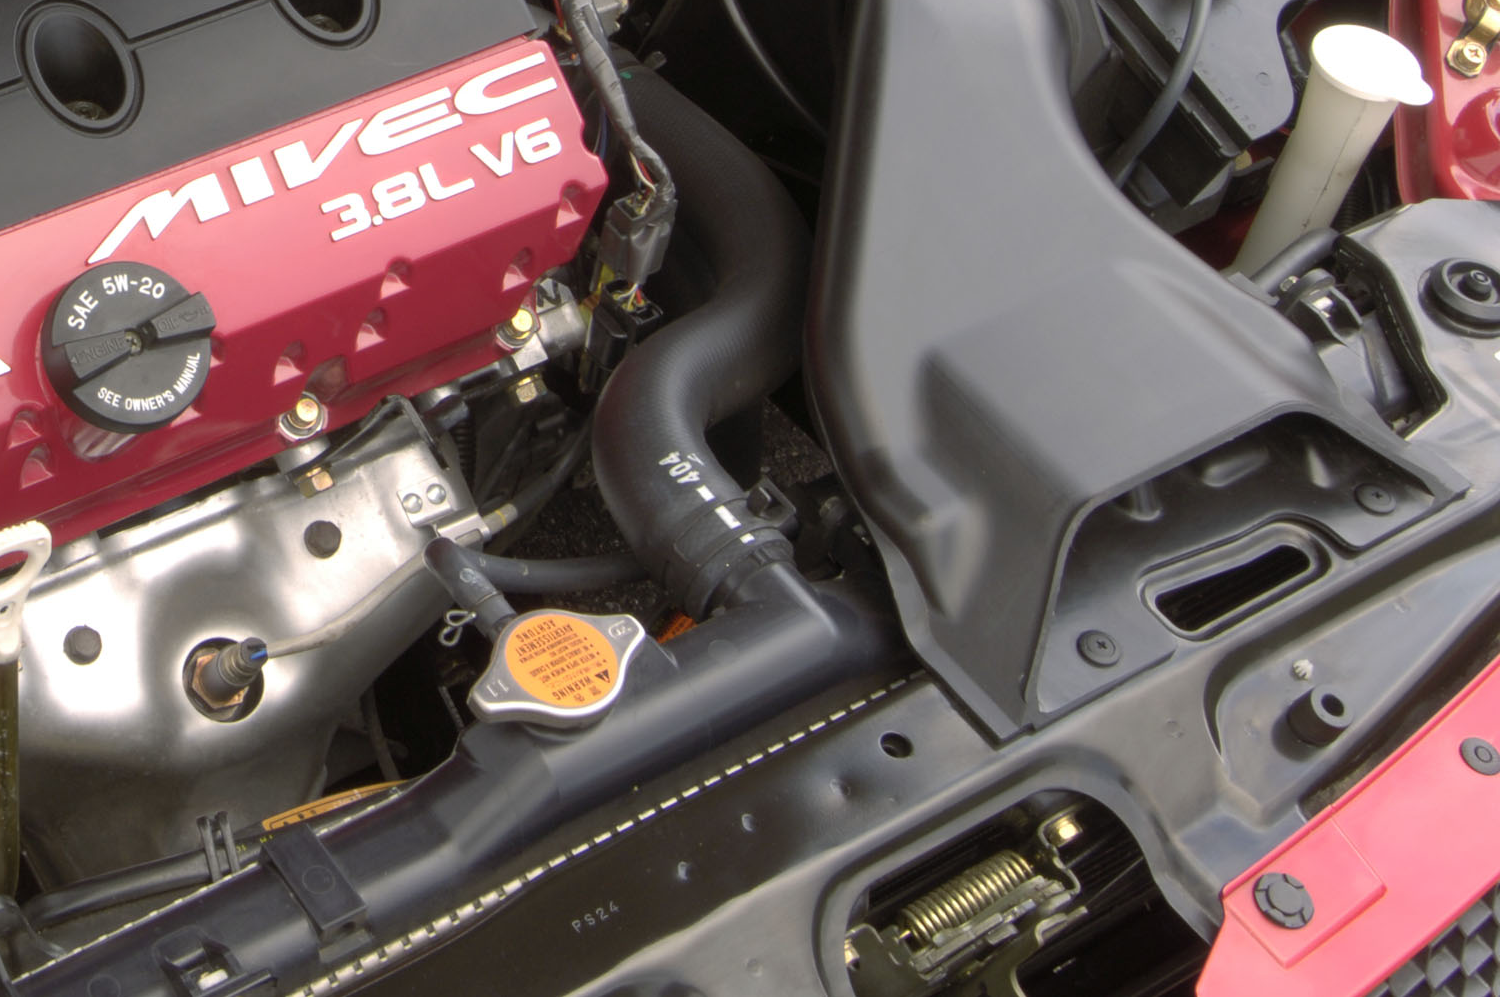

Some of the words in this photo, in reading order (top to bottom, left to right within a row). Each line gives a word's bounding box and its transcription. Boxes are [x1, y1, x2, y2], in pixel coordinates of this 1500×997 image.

[86, 51, 558, 265] MIVEC
[319, 162, 476, 243] 3.8L
[469, 116, 563, 177] V6
[67, 290, 99, 331] SAE
[102, 274, 166, 300] 5W-20
[97, 387, 122, 407] SEE
[125, 389, 176, 412] OWNER'S
[173, 352, 201, 395] MANUAL
[515, 624, 574, 656] AVERTISSEMENT
[516, 619, 557, 642] ACHTUNG
[552, 676, 593, 701] WARNING
[571, 900, 621, 933] PS24
